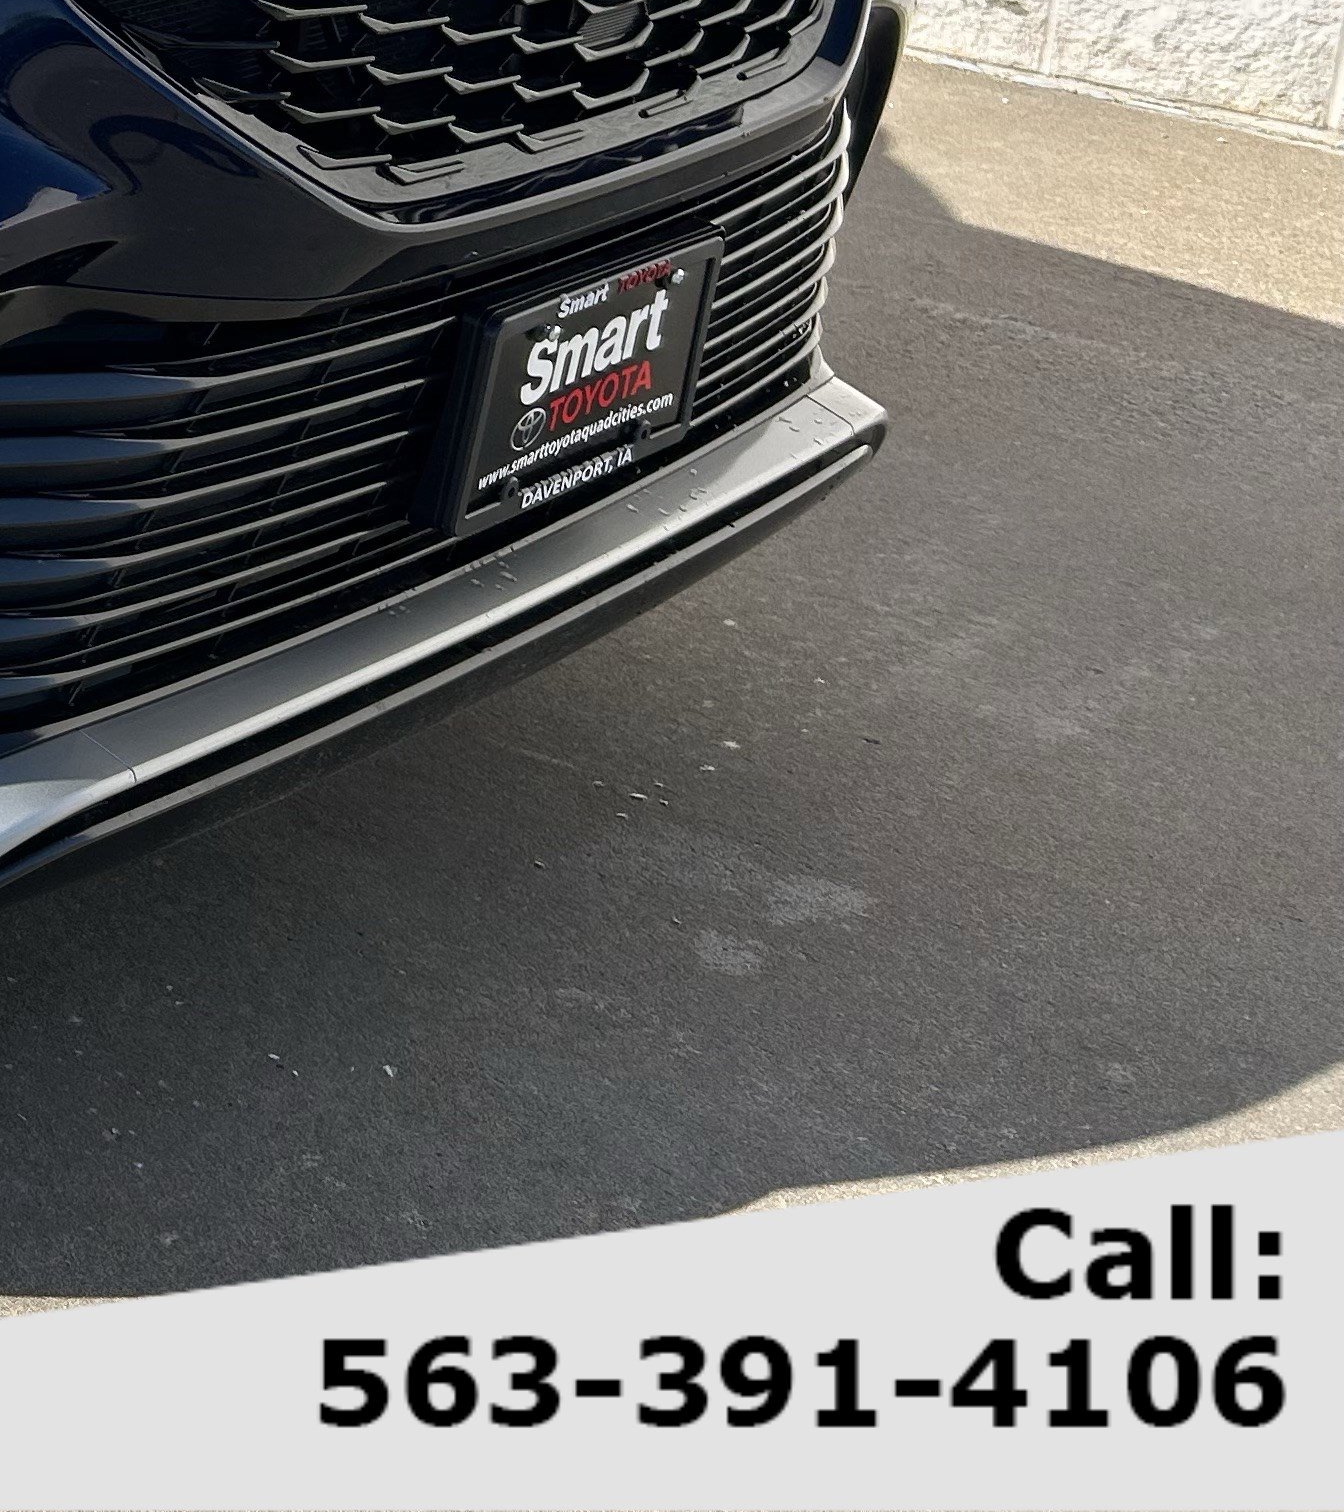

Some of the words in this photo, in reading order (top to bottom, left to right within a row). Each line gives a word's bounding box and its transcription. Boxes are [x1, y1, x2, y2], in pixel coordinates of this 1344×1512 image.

[557, 281, 610, 319] Smart
[618, 259, 672, 294] TOYOTA
[520, 289, 669, 406] Smart
[547, 360, 652, 432] TOYOTA
[478, 392, 674, 491] www.smarttoyotaquadcities.com
[521, 457, 613, 509] DAVENPORT,
[617, 448, 633, 468] IA
